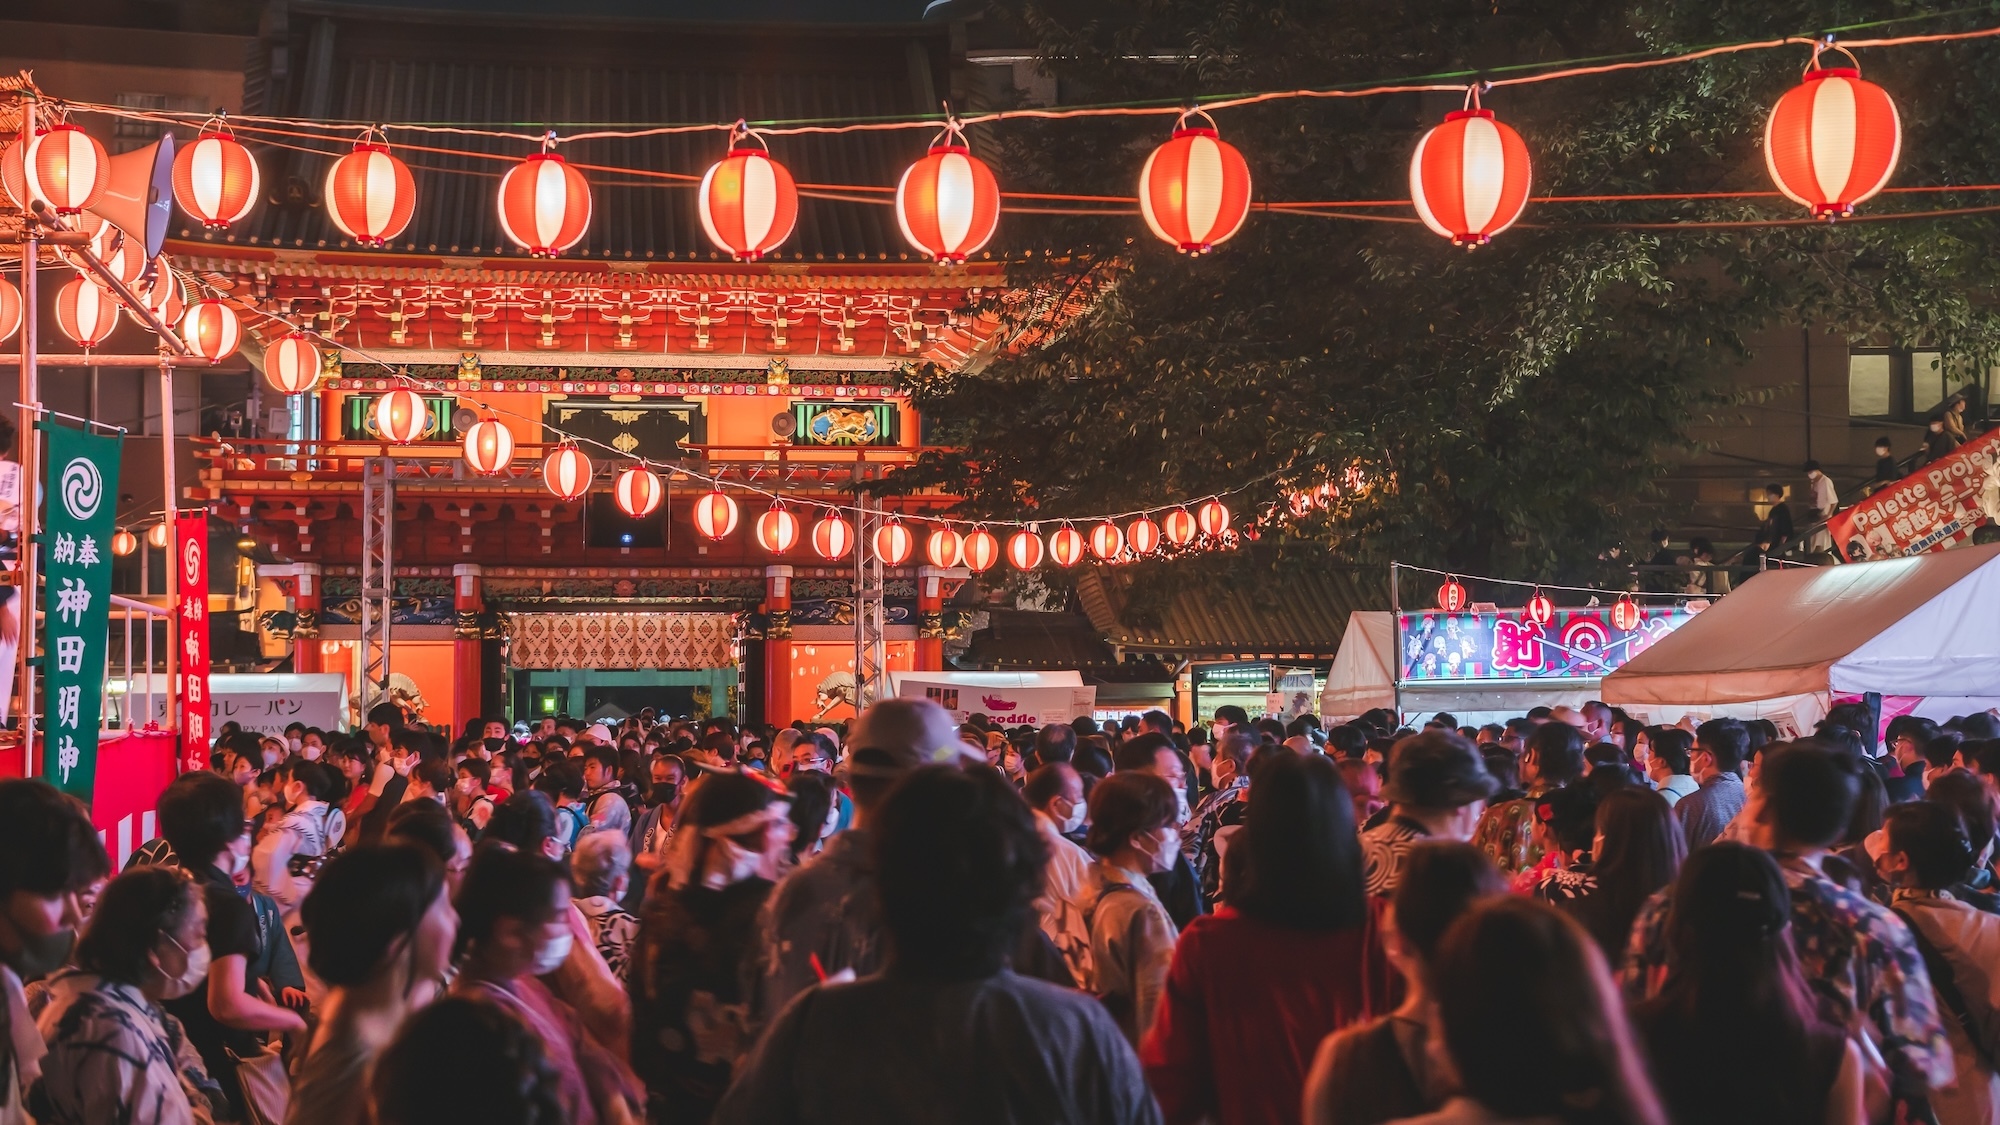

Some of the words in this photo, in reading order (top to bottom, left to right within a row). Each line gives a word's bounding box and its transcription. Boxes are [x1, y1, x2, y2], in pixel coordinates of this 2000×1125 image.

[1852, 483, 1927, 532] Palette
[56, 577, 92, 784] 神田明神
